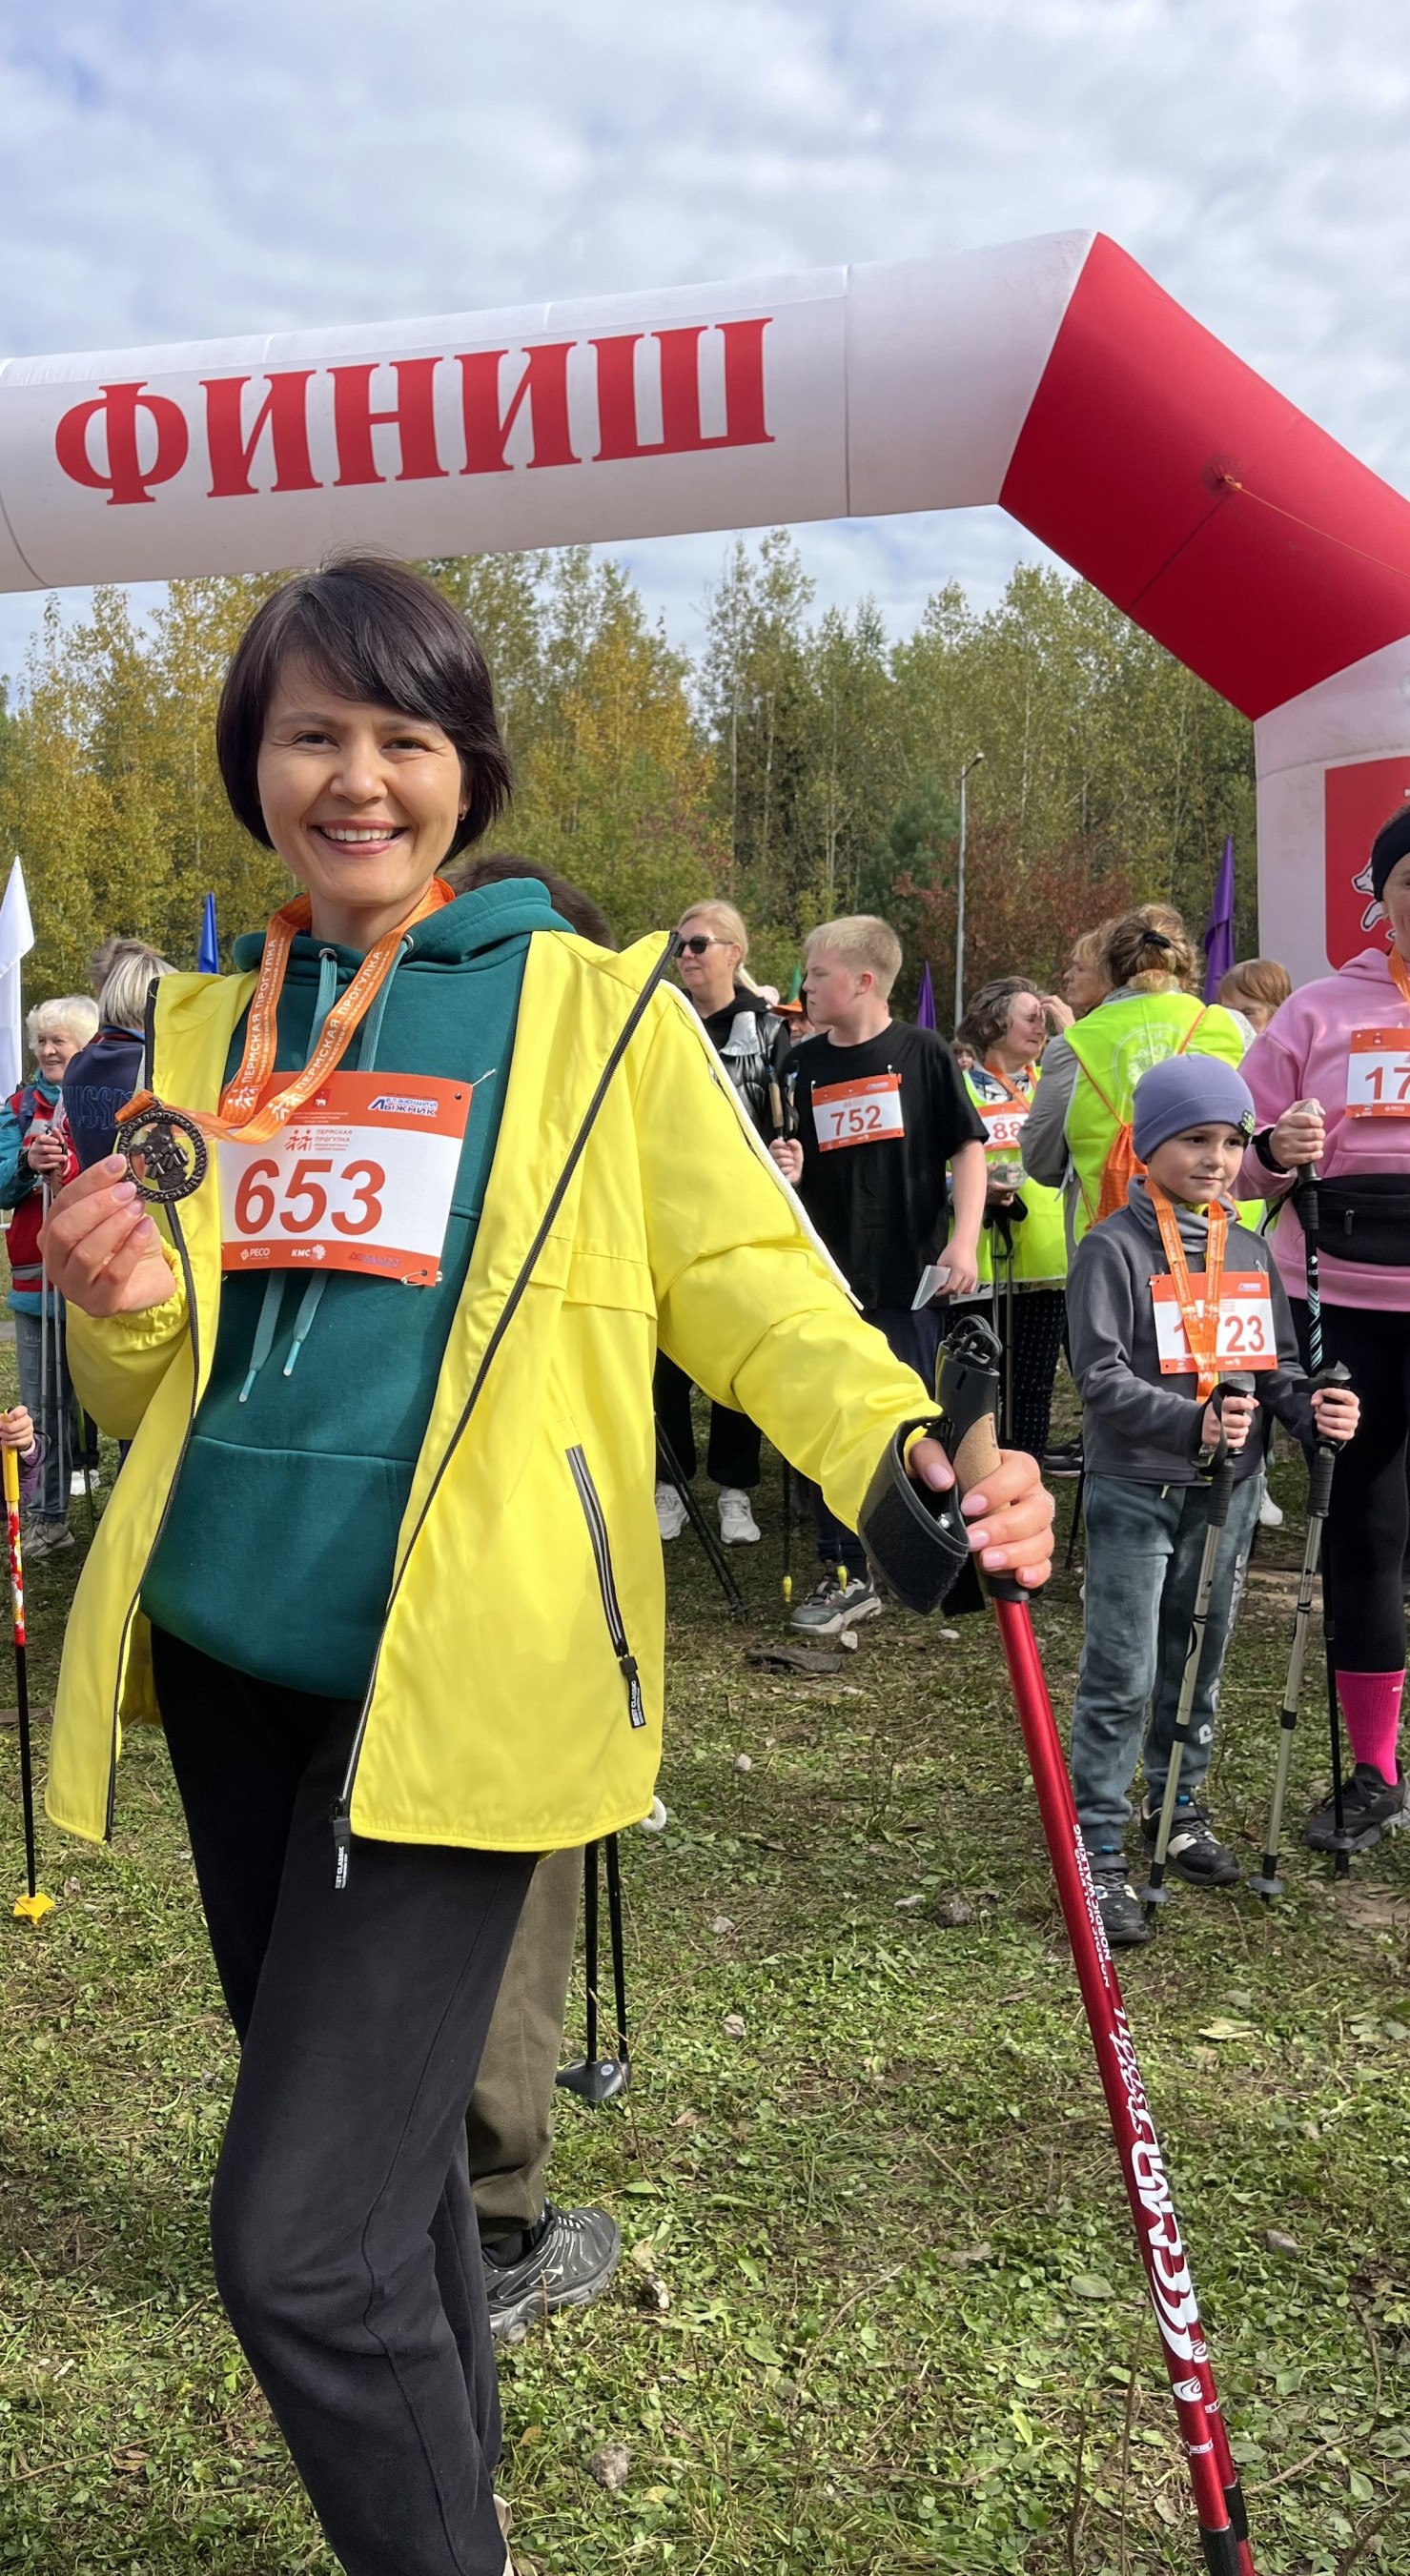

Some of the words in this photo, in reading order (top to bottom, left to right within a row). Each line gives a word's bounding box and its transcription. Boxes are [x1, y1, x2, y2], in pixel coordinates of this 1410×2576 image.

[55, 317, 775, 505] ФИНИШ
[242, 1012, 261, 1084] ПЕРМСКАЯ
[255, 939, 277, 1008] ПРОГУЛКА
[295, 1017, 340, 1090] ПЕРМСКАЯ
[337, 950, 383, 1017] ПРОГУЛКА
[830, 1105, 883, 1136] 752
[235, 1159, 386, 1236] 653
[1073, 1824, 1095, 1898] WALKING
[1092, 1899, 1112, 1960] NORDIC
